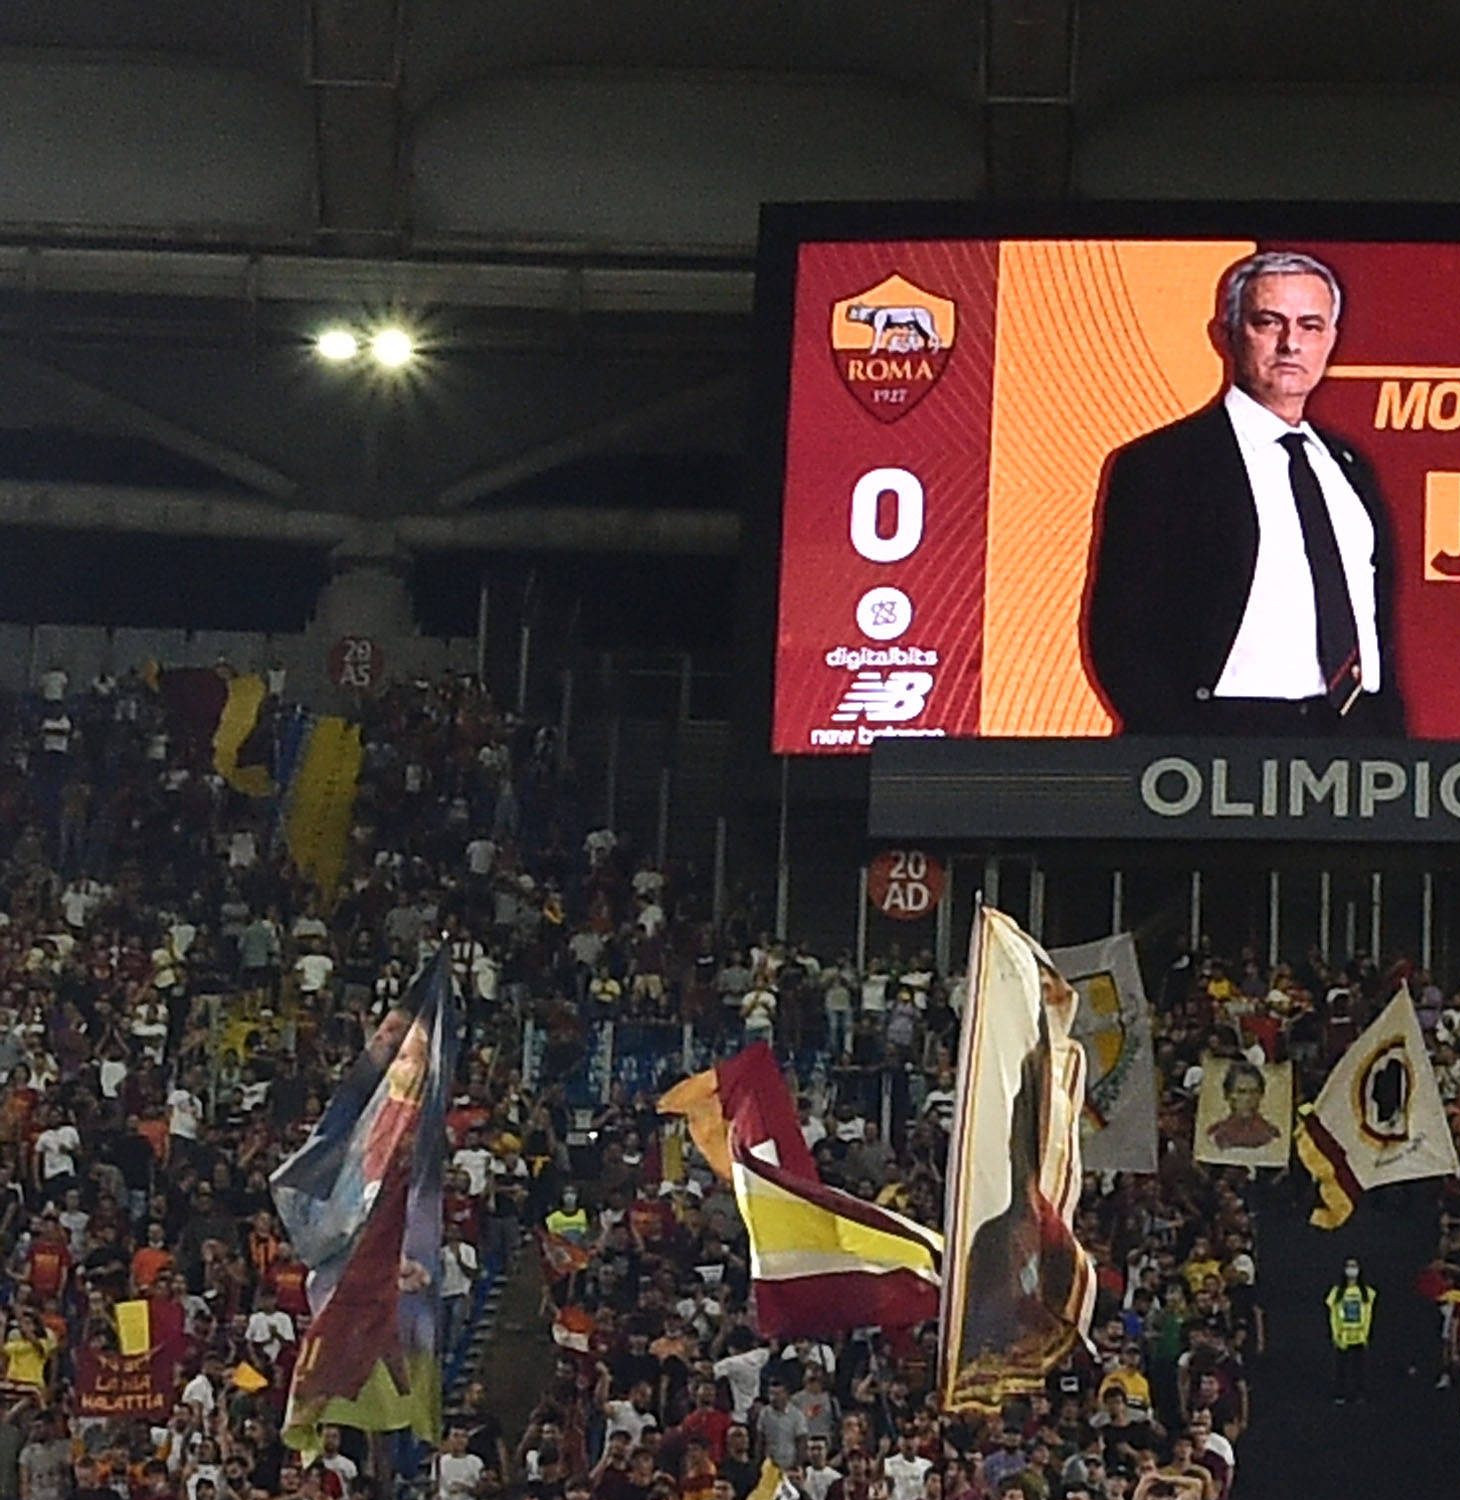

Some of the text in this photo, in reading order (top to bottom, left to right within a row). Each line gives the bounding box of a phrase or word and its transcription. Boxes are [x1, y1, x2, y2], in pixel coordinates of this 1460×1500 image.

[848, 359, 933, 381] ROMA
[849, 466, 925, 564] 0
[890, 850, 927, 880] 20
[882, 882, 930, 912] AD
